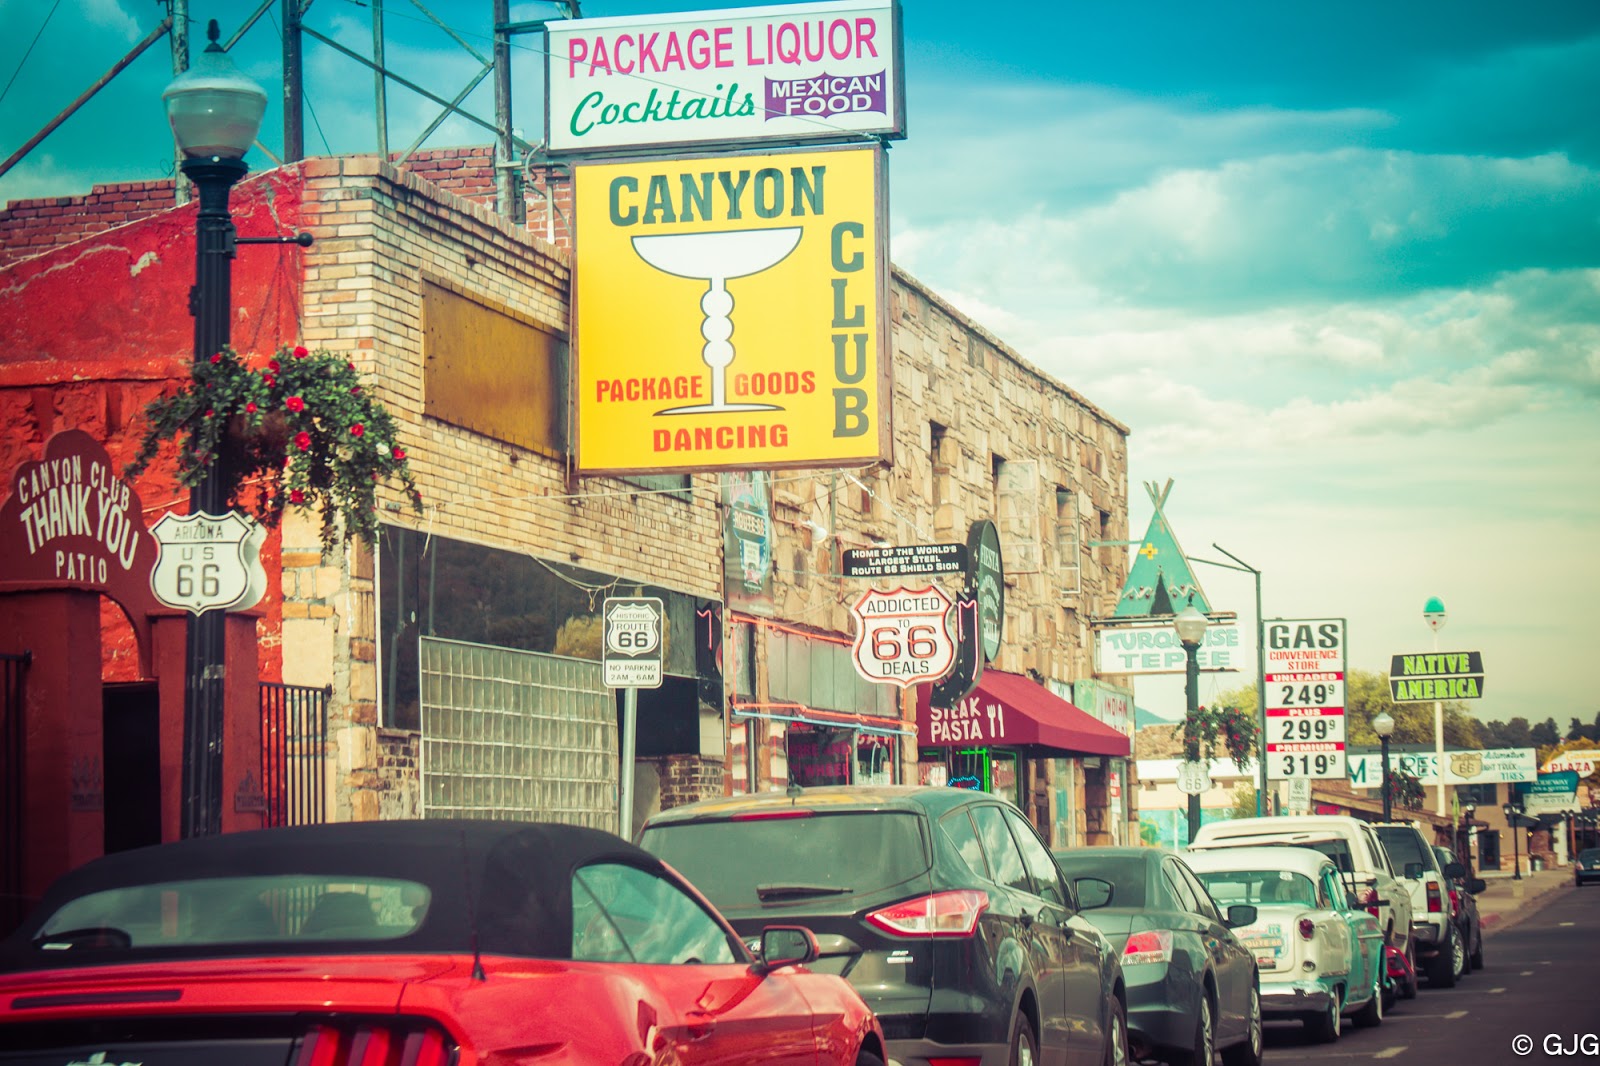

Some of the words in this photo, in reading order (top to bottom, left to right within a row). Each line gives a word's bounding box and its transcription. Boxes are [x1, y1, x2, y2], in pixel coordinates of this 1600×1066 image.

[569, 27, 734, 78] PACKAGE
[747, 18, 878, 66] LIQUOR
[772, 75, 881, 98] MEXICAN
[570, 83, 755, 137] Cocktails
[785, 94, 873, 115] FOOD
[609, 165, 826, 227] CANYON
[831, 221, 869, 438] CLUB
[596, 375, 703, 403] PACKAGE
[734, 370, 816, 397] GOODS
[653, 424, 788, 452] DANCING
[18, 455, 81, 504] CANYON
[90, 461, 130, 512] CLUB
[20, 483, 92, 555] THANK
[97, 491, 139, 570] YOU
[174, 524, 224, 540] ARIZONA
[55, 549, 107, 584] PATIO
[884, 564, 898, 574] 66
[177, 564, 220, 597] 66
[866, 597, 941, 613] ADDICTED
[616, 623, 650, 631] ROUTE
[898, 619, 910, 629] TO
[618, 631, 648, 648] 66
[872, 625, 938, 661] 66
[1105, 628, 1239, 651] TURQISE
[1269, 624, 1339, 650] GAS
[1269, 650, 1339, 661] CONVENIENCE
[1288, 661, 1321, 671] STORE
[1403, 653, 1470, 676] NATIVE
[882, 660, 929, 676] DEALS
[1272, 672, 1338, 683] UNLEADED
[1396, 677, 1479, 700] AMERICA
[1289, 708, 1321, 717] PLUS
[930, 718, 983, 743] PASTA
[1275, 743, 1337, 752] PREMIUM
[1551, 762, 1591, 773] PLAZA
[1185, 778, 1202, 791] 66
